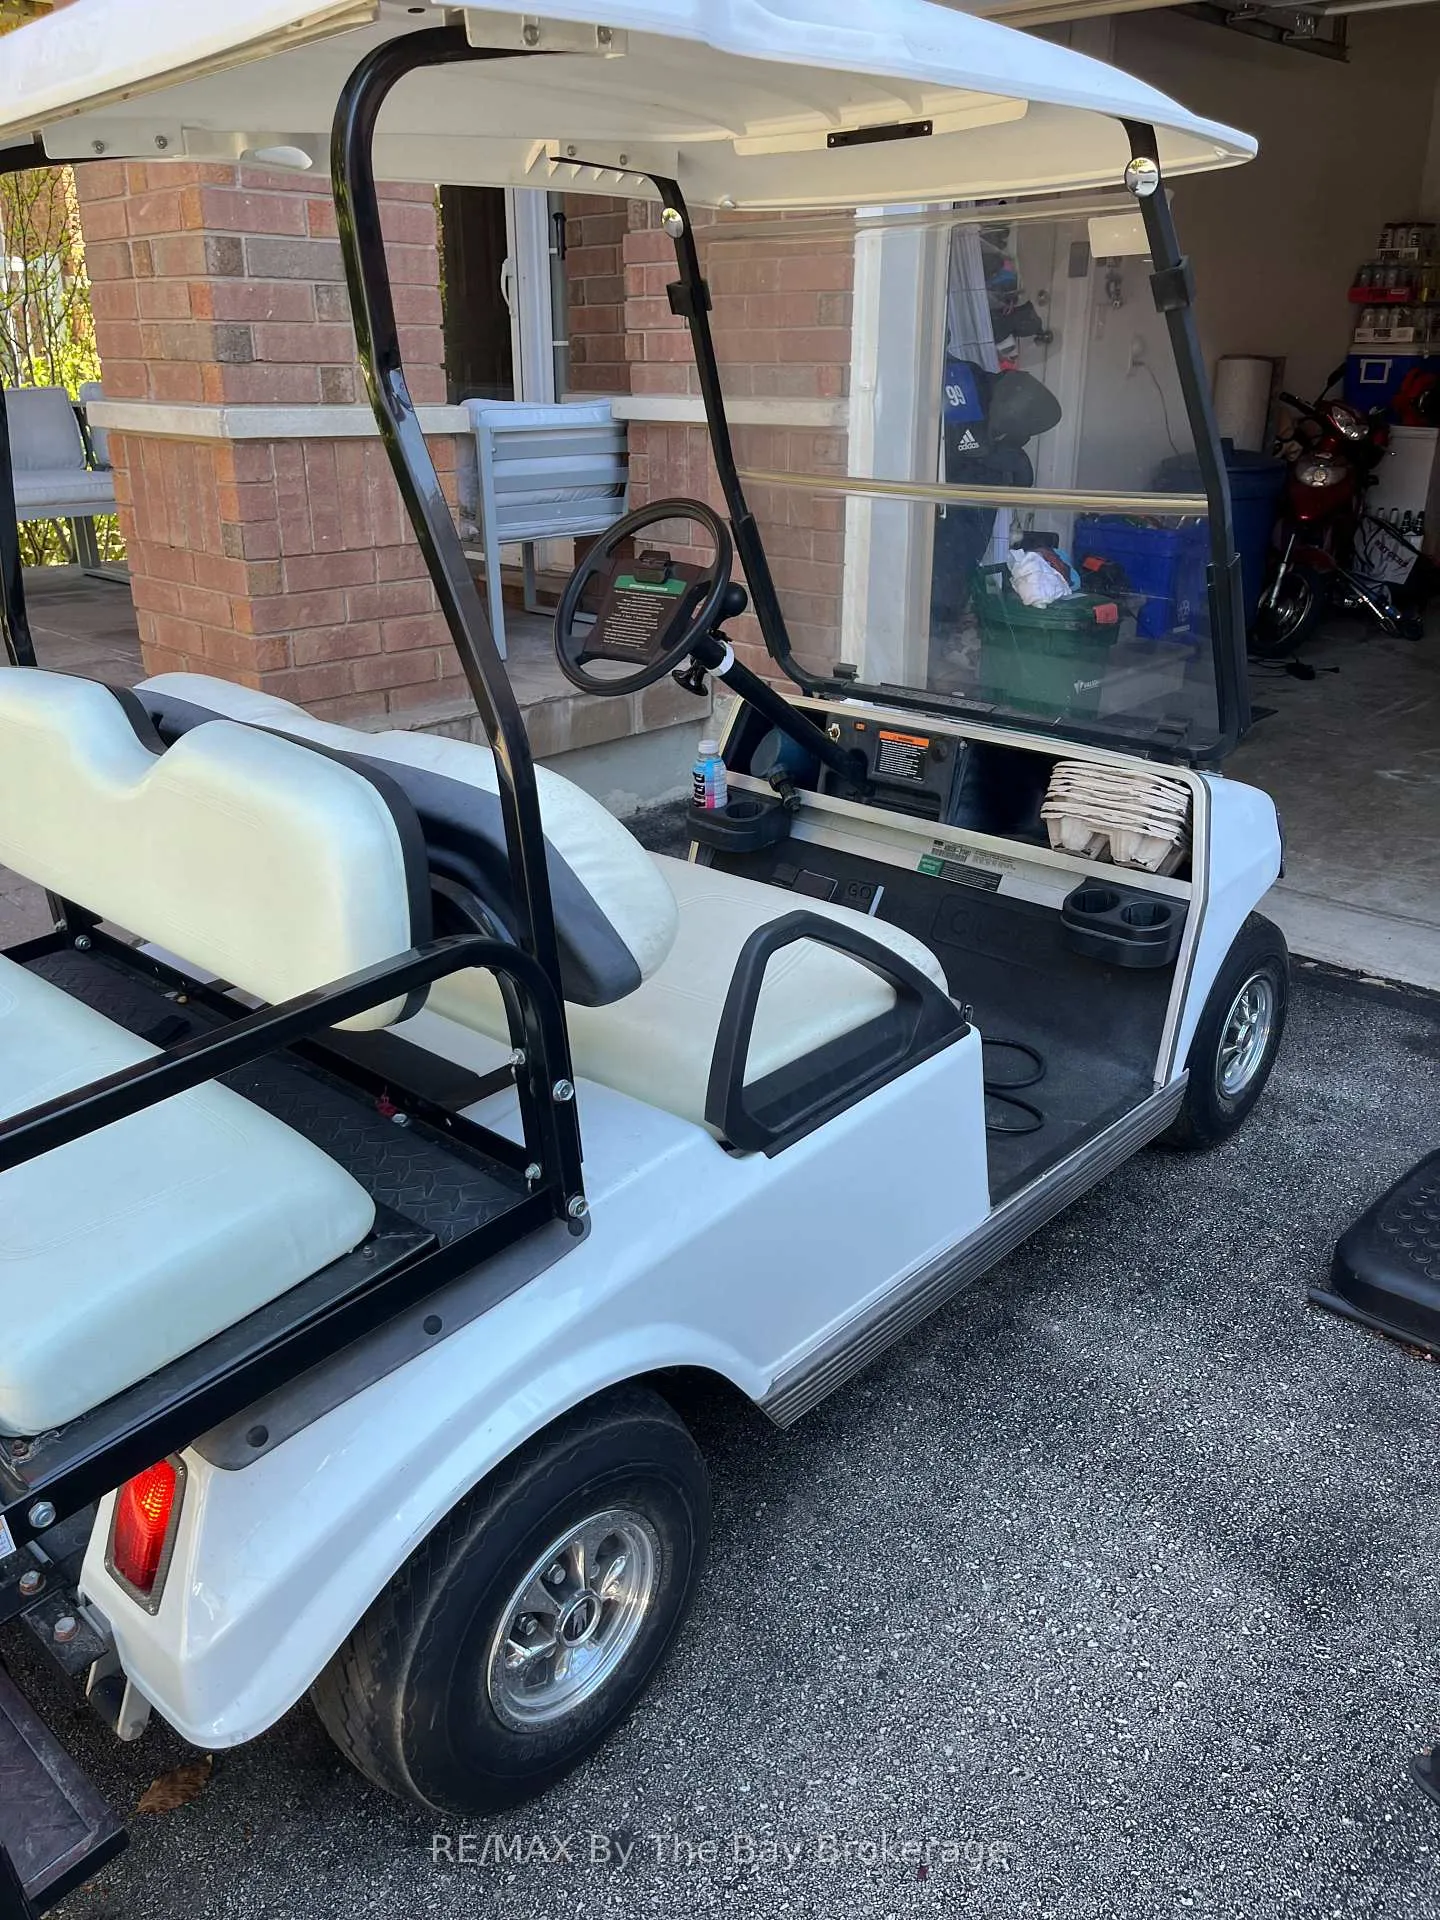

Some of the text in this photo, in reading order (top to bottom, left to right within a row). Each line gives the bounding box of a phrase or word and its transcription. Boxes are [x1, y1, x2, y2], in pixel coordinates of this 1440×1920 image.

[945, 385, 966, 407] 99
[958, 442, 980, 451] adidas
[848, 882, 872, 900] GO
